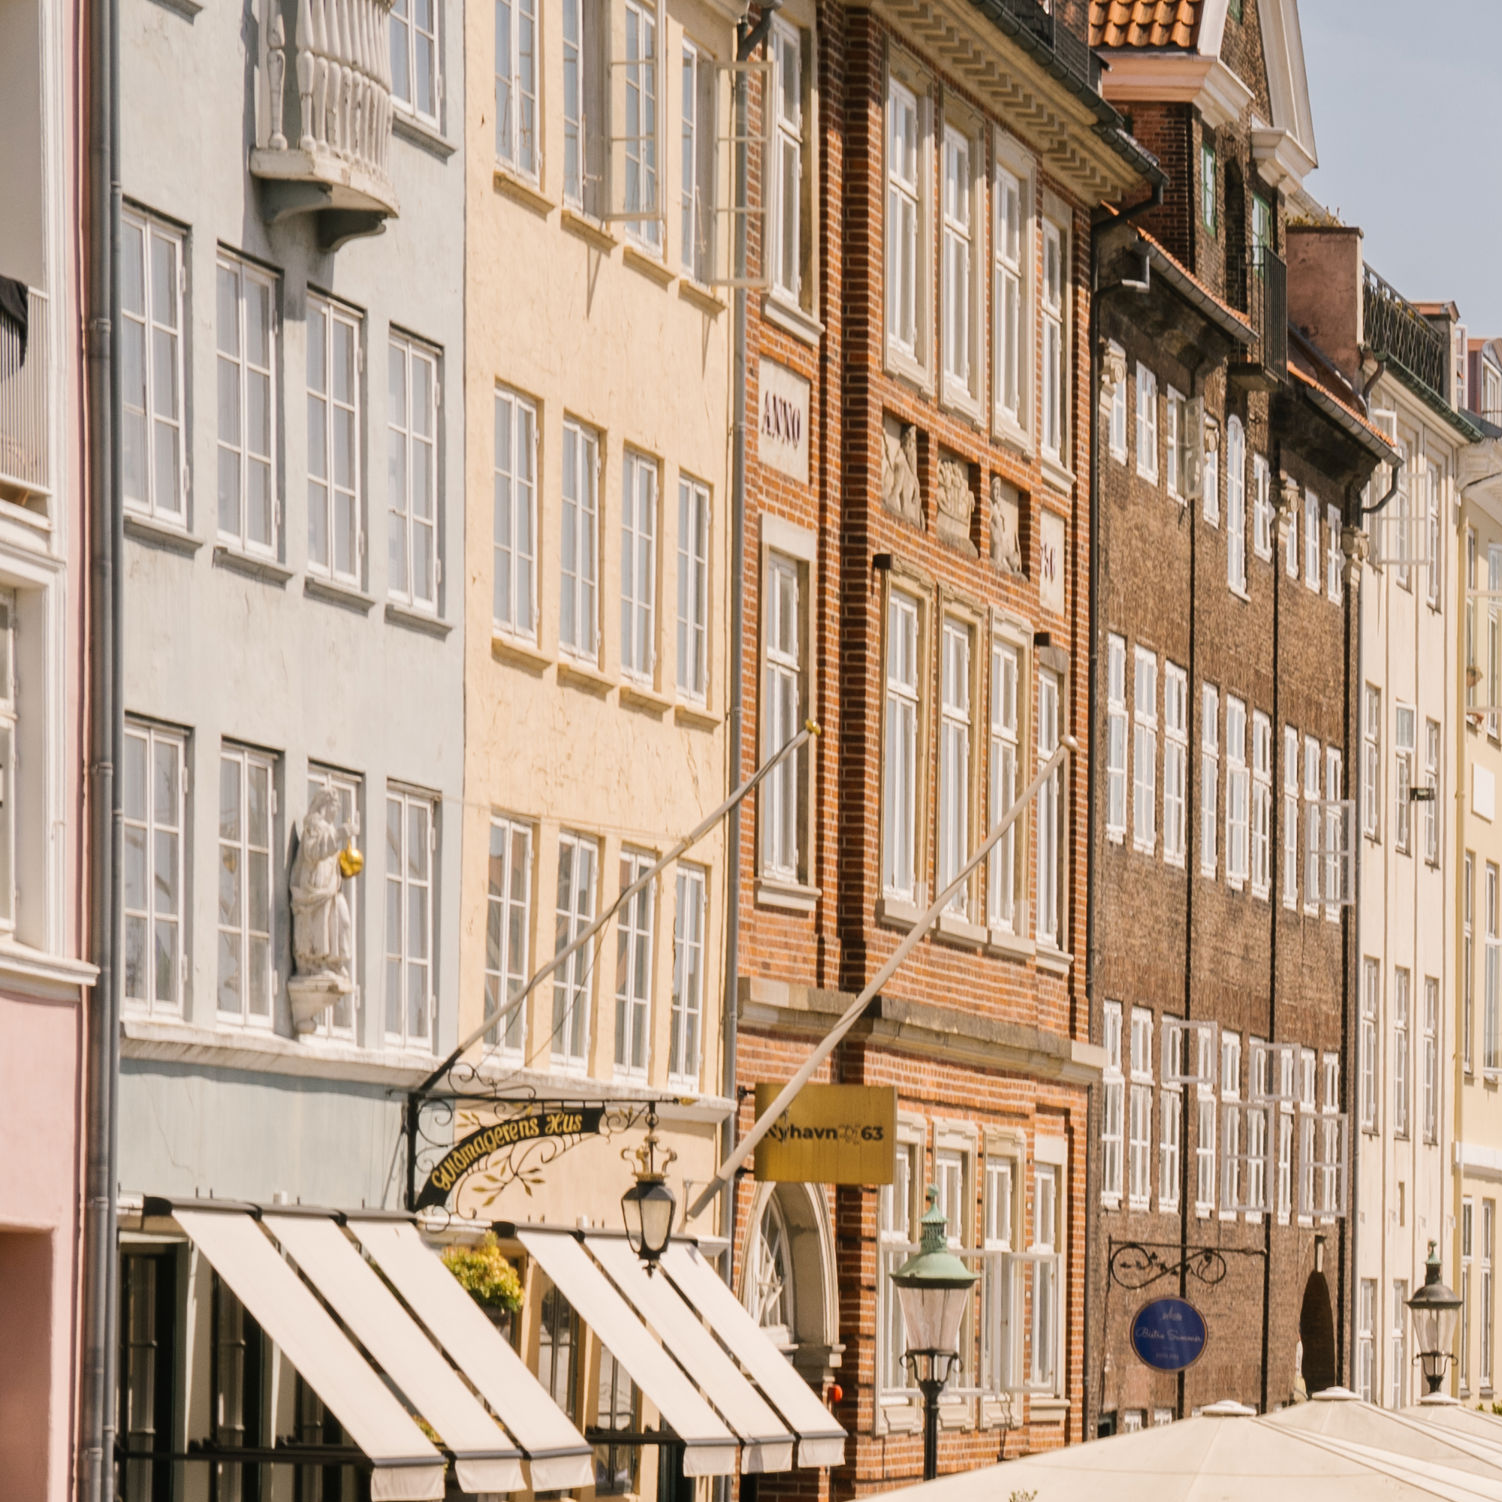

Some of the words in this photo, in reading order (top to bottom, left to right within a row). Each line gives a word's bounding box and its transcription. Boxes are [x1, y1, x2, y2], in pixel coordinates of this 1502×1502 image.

[761, 391, 801, 450] ANNO
[545, 1112, 583, 1135] Hus
[861, 1125, 884, 1141] 63
